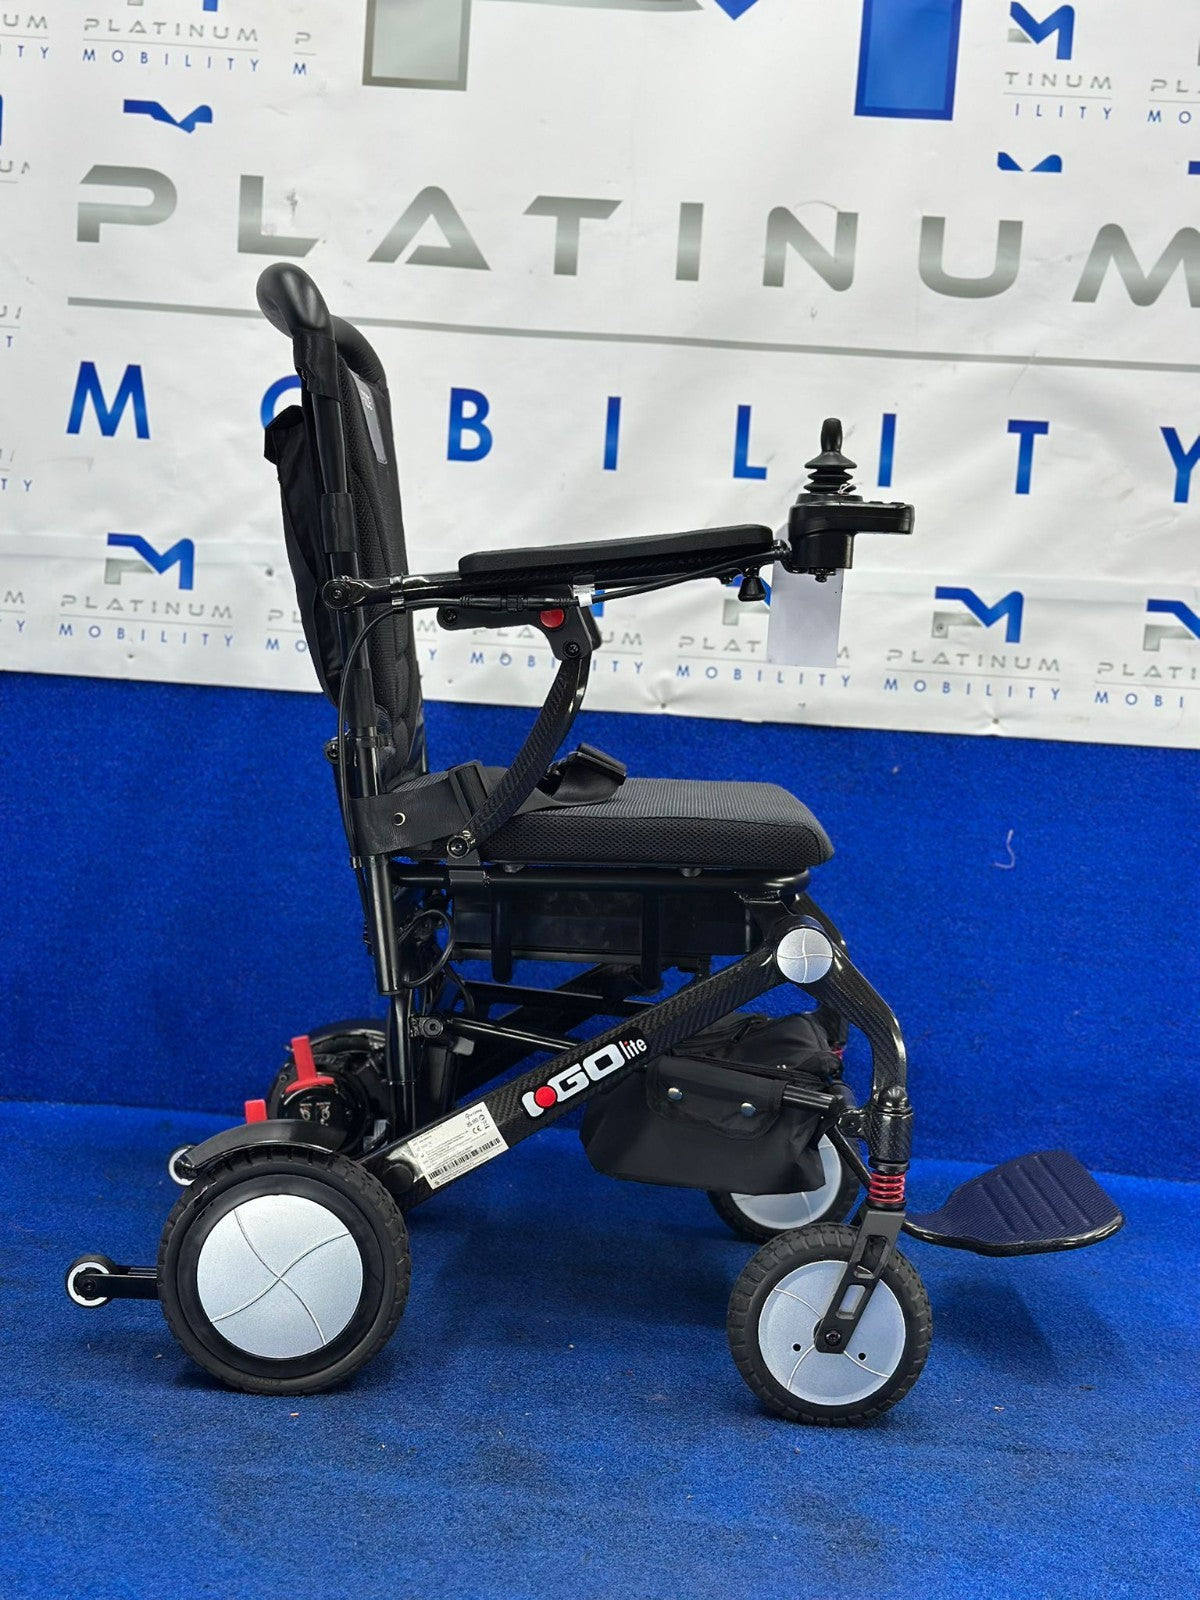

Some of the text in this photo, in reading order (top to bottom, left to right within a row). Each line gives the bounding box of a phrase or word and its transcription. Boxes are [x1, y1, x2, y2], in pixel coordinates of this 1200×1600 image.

[84, 18, 259, 42] PLATINUM
[82, 49, 259, 71] MOBILITY
[76, 164, 1200, 308] PLATINUM
[60, 594, 233, 619] PLATINUM
[58, 624, 234, 647] MOBILITY
[886, 649, 1060, 672] PLATINUM
[676, 665, 851, 688] MOBILITY
[884, 678, 1060, 701] MOBILITY
[618, 1035, 648, 1061] lite
